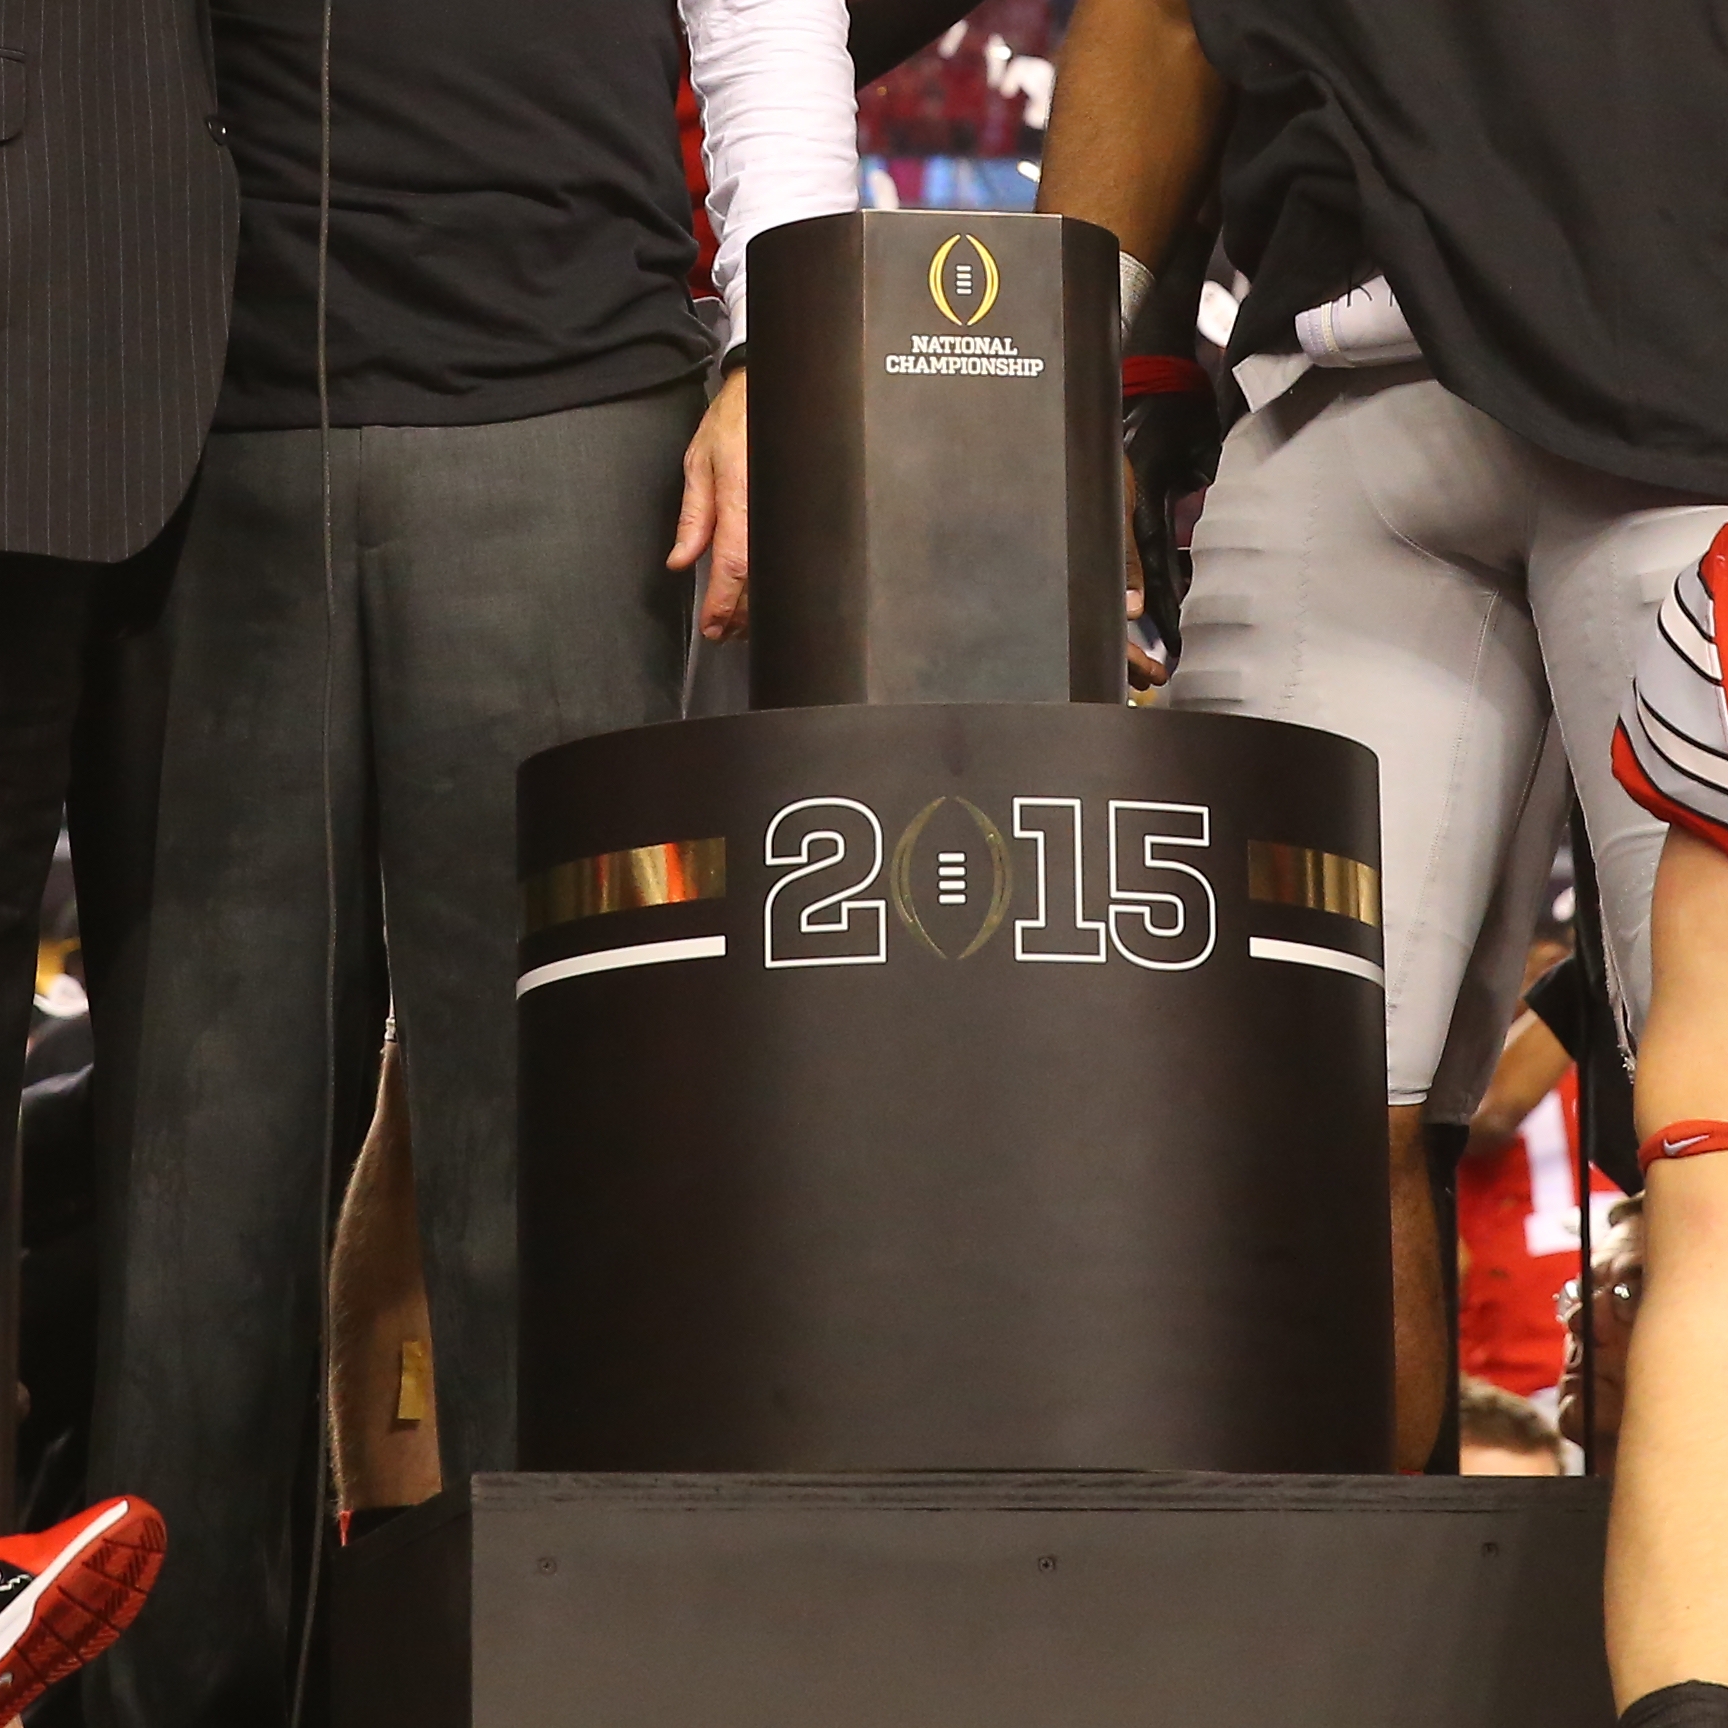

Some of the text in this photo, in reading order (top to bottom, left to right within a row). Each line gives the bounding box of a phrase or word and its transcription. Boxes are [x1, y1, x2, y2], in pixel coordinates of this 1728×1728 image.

[911, 335, 1018, 356] NATIONAL
[885, 356, 1045, 377] CHAMPIONSHIP
[764, 795, 1217, 972] 2015
